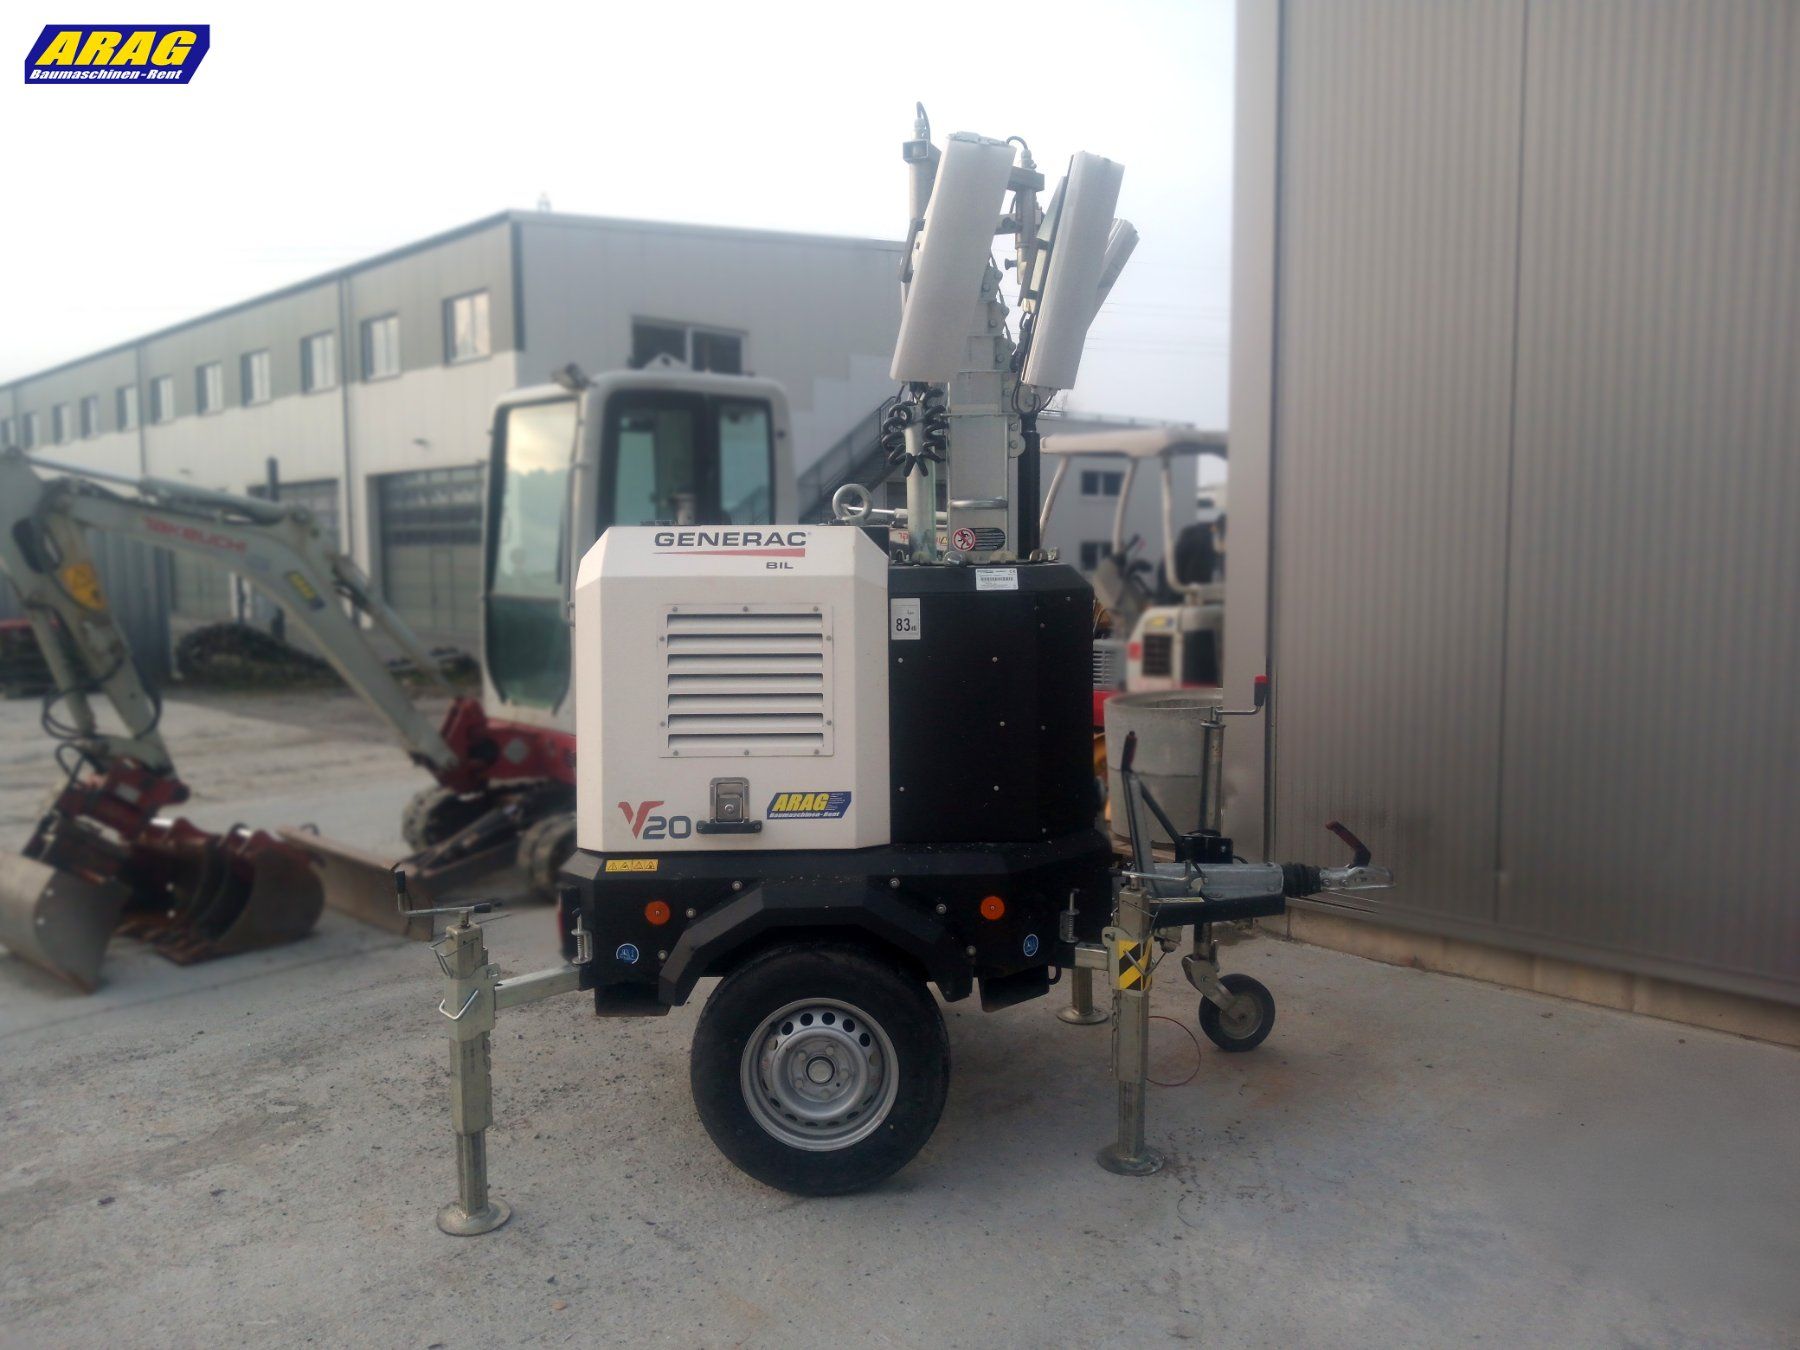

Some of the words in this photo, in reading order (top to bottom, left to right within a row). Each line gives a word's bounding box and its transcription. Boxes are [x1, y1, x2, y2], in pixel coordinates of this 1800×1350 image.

[655, 532, 806, 546] GENERAC
[896, 618, 910, 631] 83
[772, 793, 829, 811] ARAG
